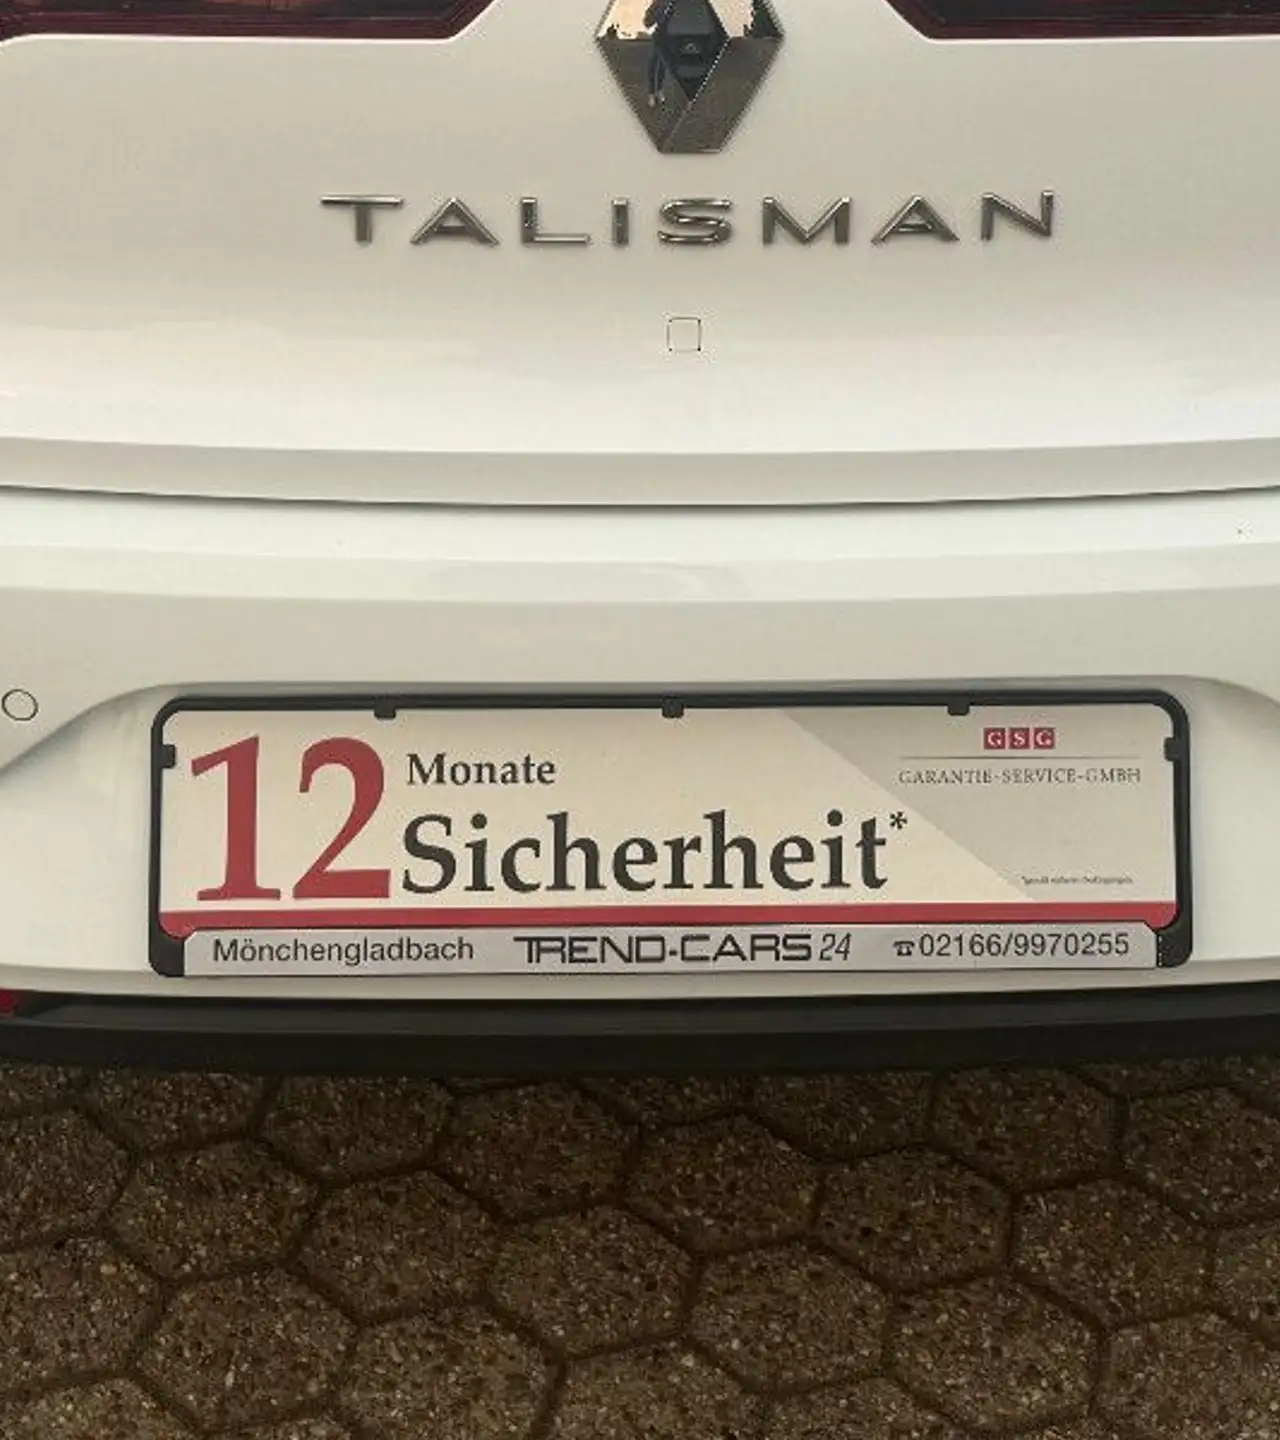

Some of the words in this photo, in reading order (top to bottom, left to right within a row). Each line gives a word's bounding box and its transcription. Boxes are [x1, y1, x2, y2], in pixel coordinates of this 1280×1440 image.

[320, 189, 1055, 246] TALISMAN
[984, 727, 1055, 749] GSG
[406, 752, 556, 786] Monate
[190, 733, 392, 901] 12
[212, 937, 474, 967] Mönchengladbach
[513, 933, 813, 964] TREND-CARS
[919, 931, 1130, 958] 02166/9970255
